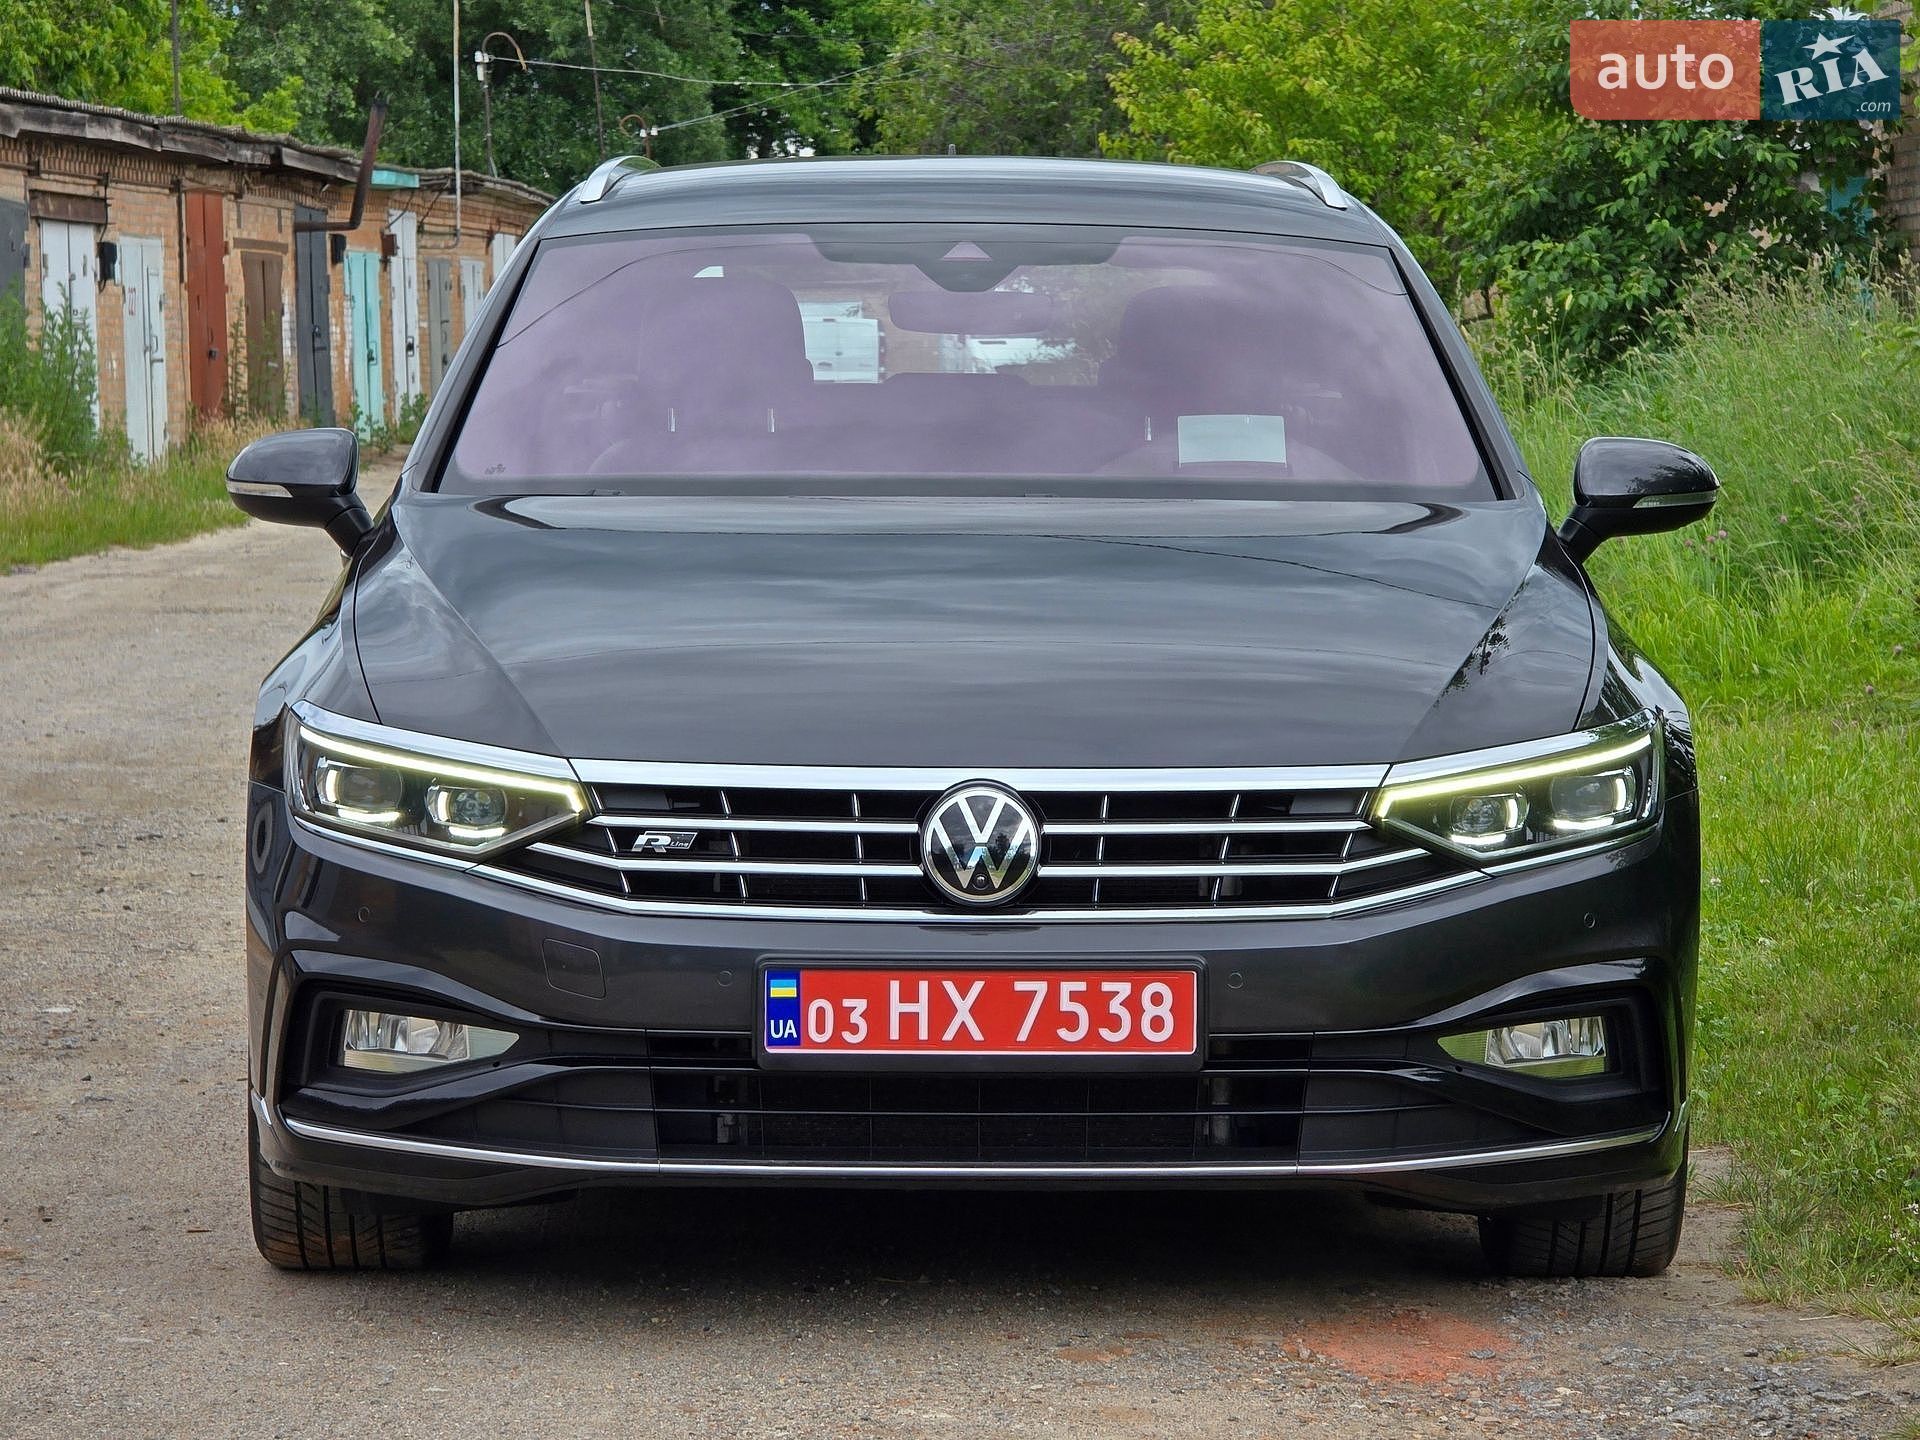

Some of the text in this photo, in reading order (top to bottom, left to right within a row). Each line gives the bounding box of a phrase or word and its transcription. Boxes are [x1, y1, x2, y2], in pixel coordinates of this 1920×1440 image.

[770, 1019, 798, 1039] UA
[807, 980, 1174, 1043] 03 HX 7538
